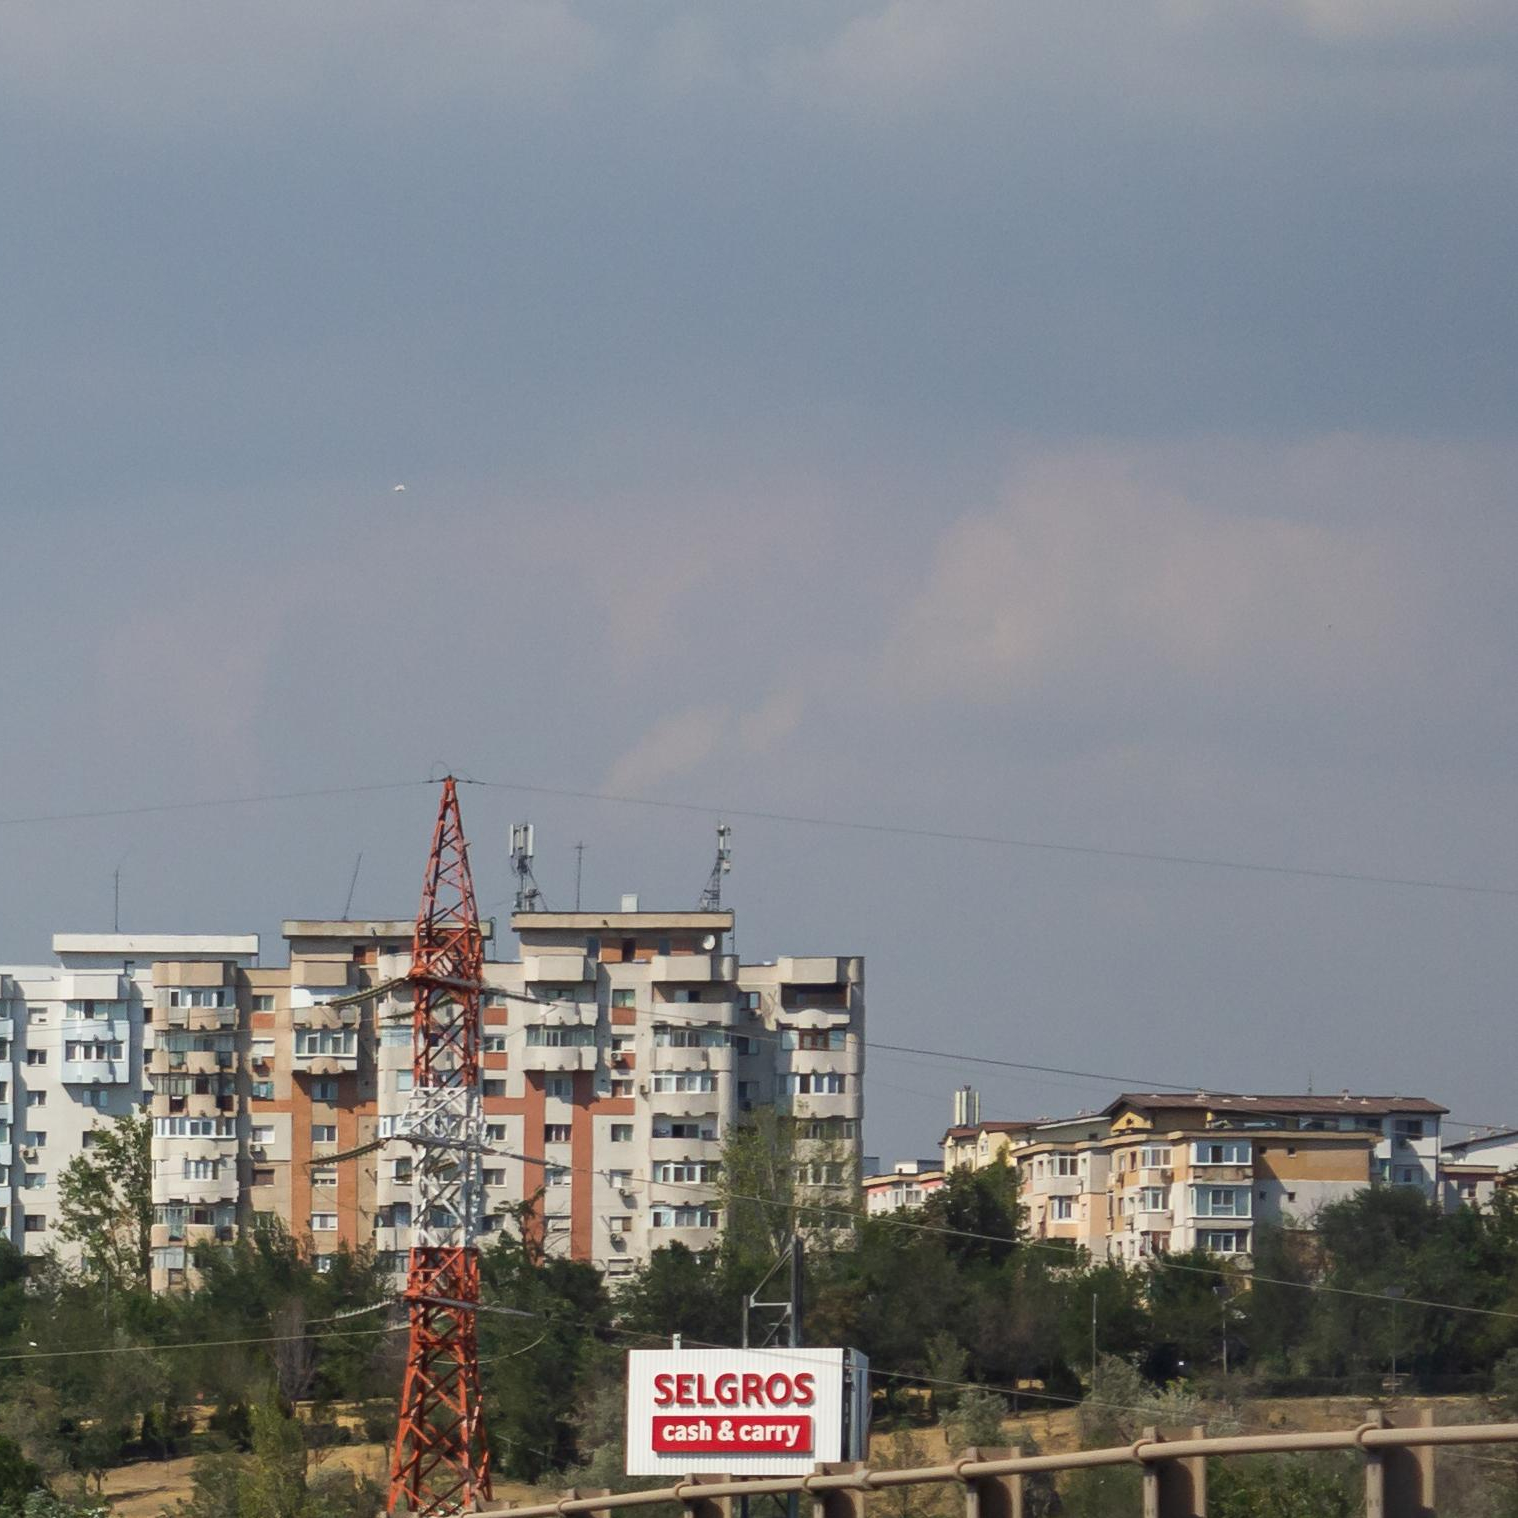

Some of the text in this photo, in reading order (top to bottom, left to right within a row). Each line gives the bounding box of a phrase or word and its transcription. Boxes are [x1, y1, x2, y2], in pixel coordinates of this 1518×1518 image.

[653, 1372, 815, 1407] SELGROS
[662, 1420, 801, 1448] cash & carry
